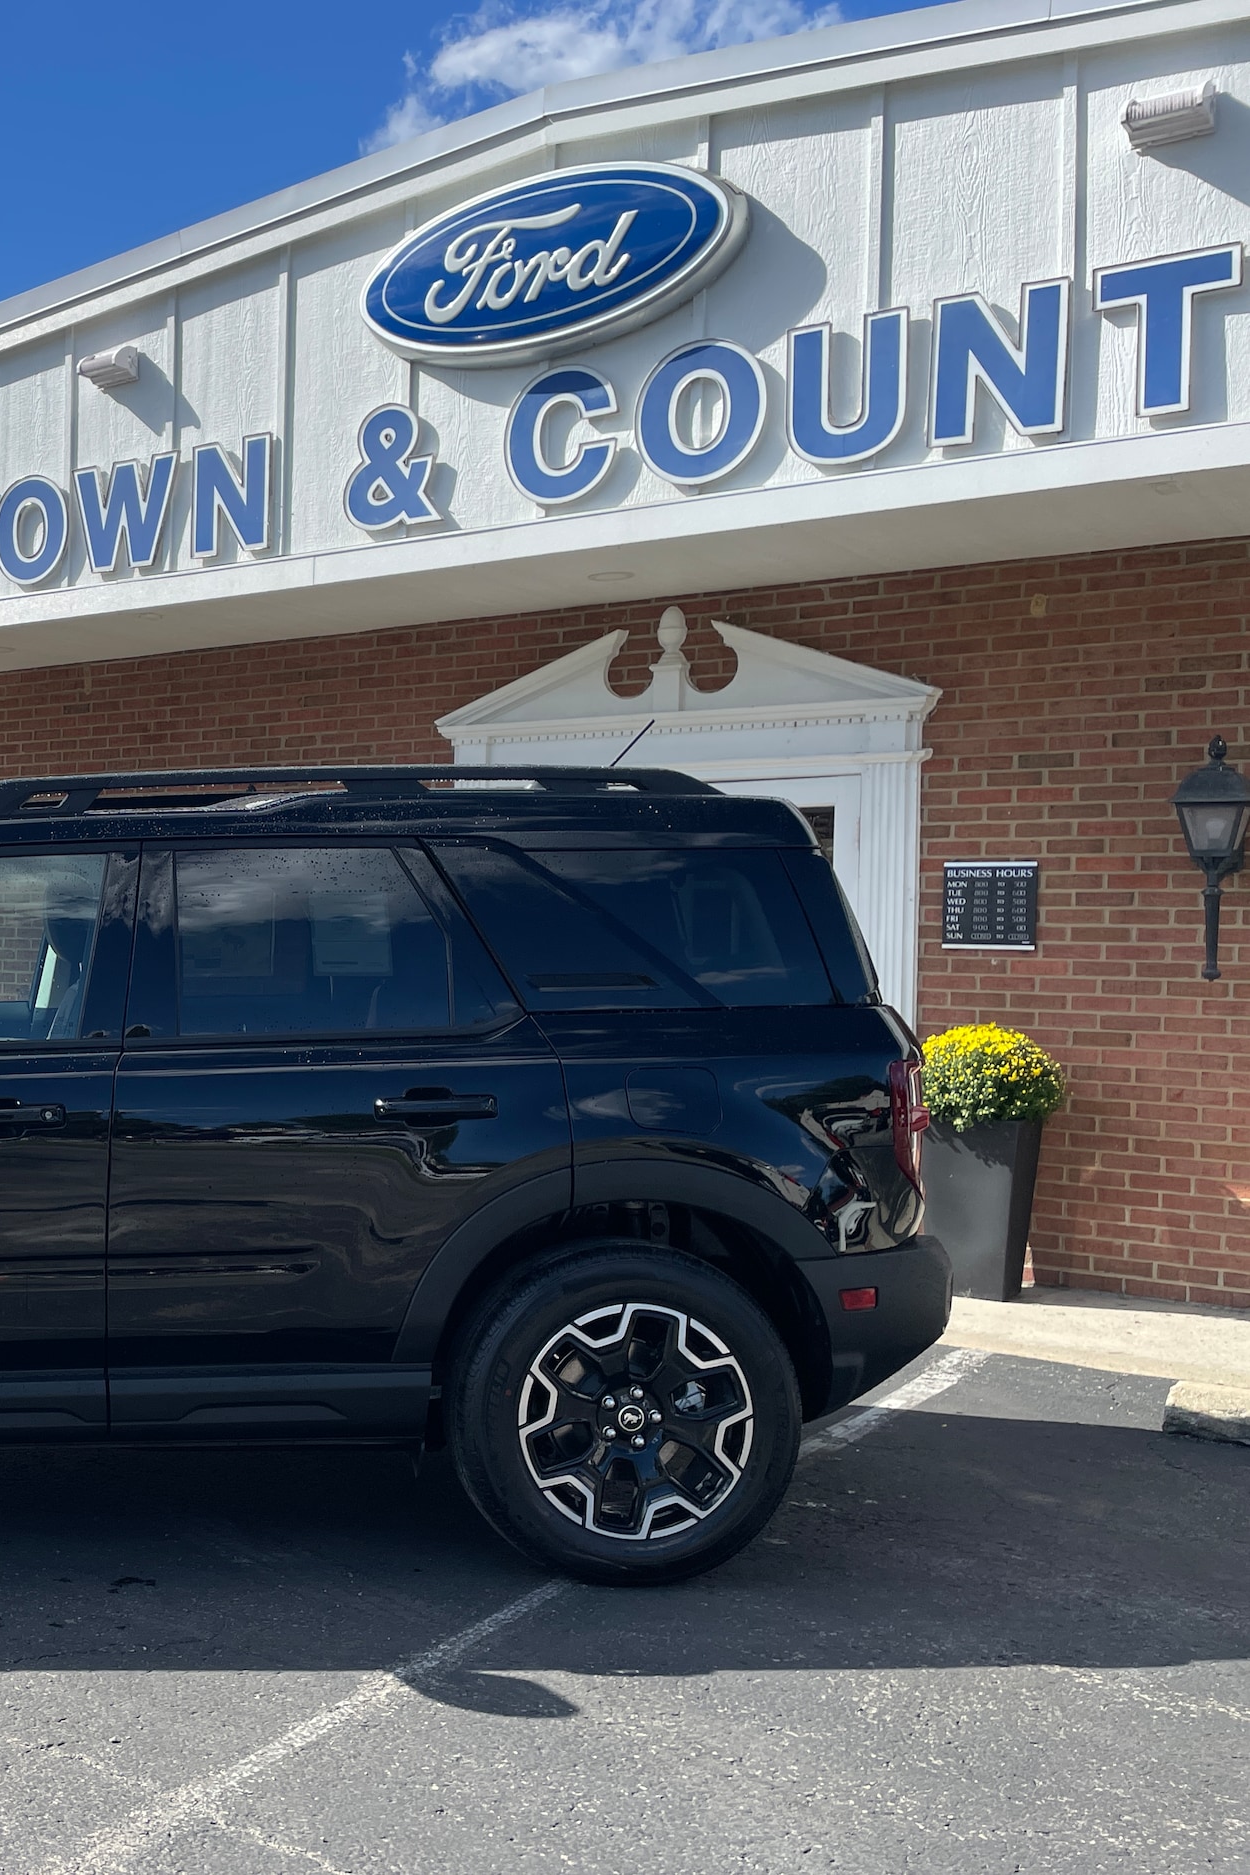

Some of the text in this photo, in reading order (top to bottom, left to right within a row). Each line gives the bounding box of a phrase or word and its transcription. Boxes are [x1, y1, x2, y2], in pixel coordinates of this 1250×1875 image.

[424, 202, 638, 324] Ford
[344, 403, 444, 531] &
[504, 241, 1242, 506] COUNT
[947, 869, 1033, 878] BUSINESS HOURS
[948, 889, 963, 897] TUE
[946, 932, 963, 940] SUN
